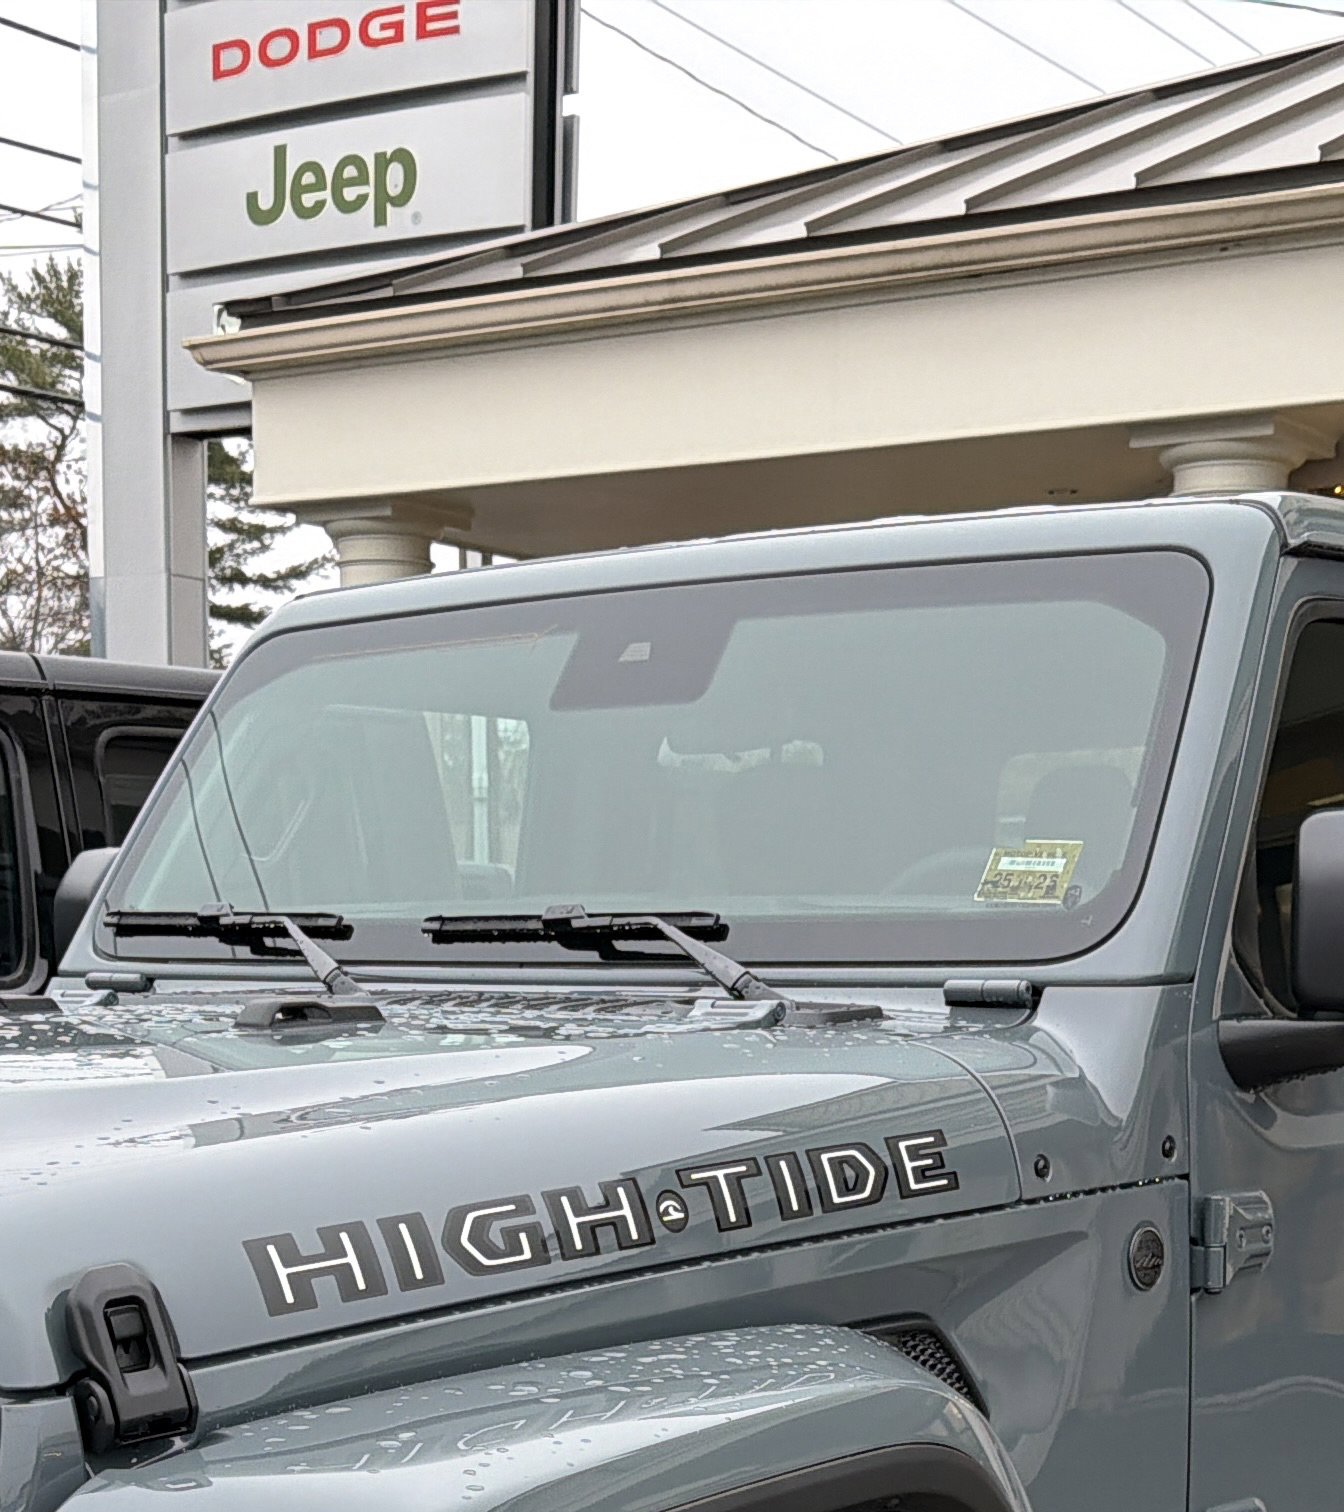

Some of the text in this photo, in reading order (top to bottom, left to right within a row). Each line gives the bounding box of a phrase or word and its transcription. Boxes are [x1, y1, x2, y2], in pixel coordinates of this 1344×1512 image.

[211, 0, 461, 81] DODGE
[245, 143, 419, 228] Jeep
[242, 1128, 960, 1317] HIGH TIDE
